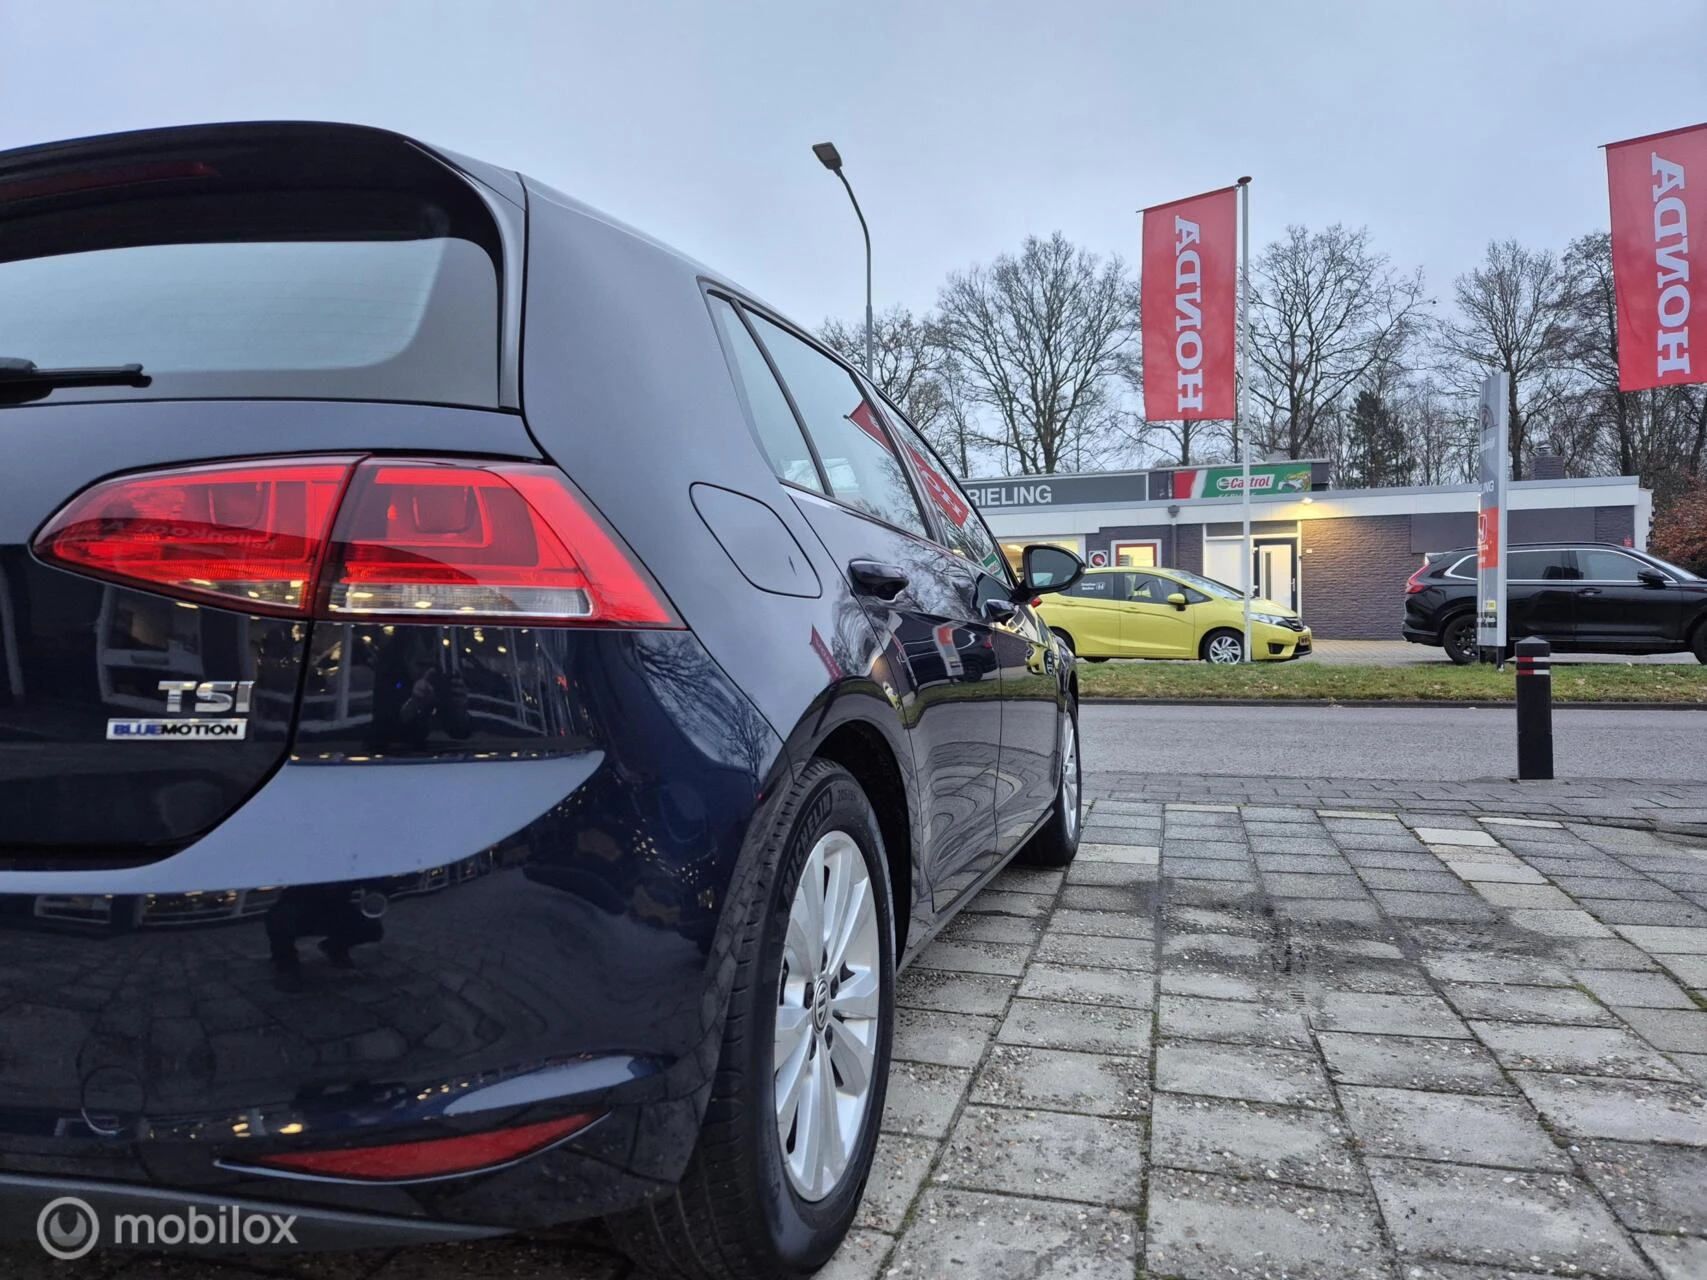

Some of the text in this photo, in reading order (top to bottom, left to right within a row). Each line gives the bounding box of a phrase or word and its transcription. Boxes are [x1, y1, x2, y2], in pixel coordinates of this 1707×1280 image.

[1230, 476, 1271, 489] Catrol
[157, 680, 255, 713] TSI
[112, 722, 239, 736] BLUEMOTION
